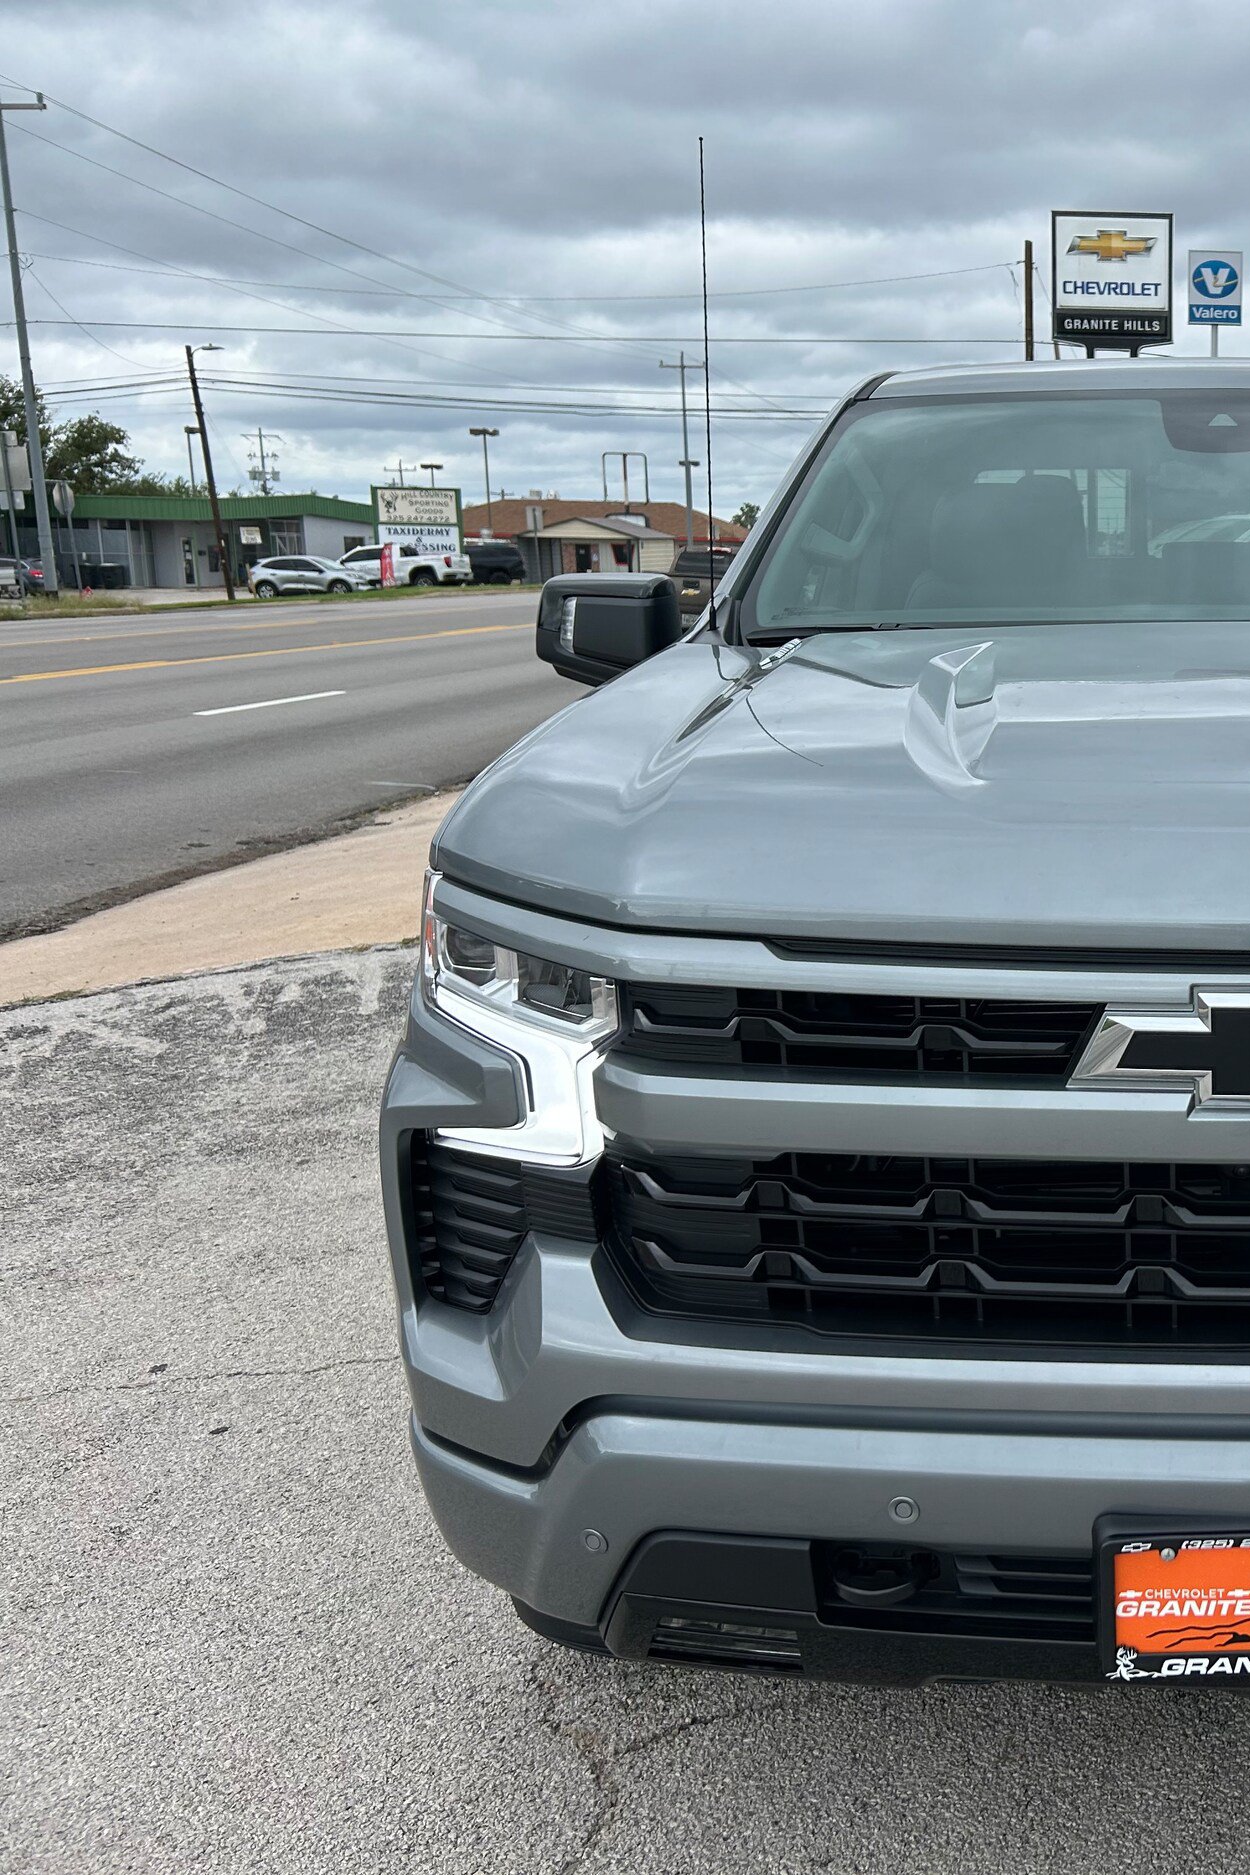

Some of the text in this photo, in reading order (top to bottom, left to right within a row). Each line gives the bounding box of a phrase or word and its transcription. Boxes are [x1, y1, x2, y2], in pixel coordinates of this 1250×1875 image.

[1062, 280, 1161, 297] CHEVROLET
[1192, 306, 1238, 319] Valero
[1064, 318, 1160, 332] GRANITE HILLS
[401, 490, 453, 502] HILL COUNTRY
[408, 499, 449, 507] SPORTING
[415, 506, 443, 514] GOODS
[385, 527, 451, 536] TAXIDERMY
[1181, 1539, 1234, 1550] (325)
[1145, 1588, 1225, 1600] CHEVROLET
